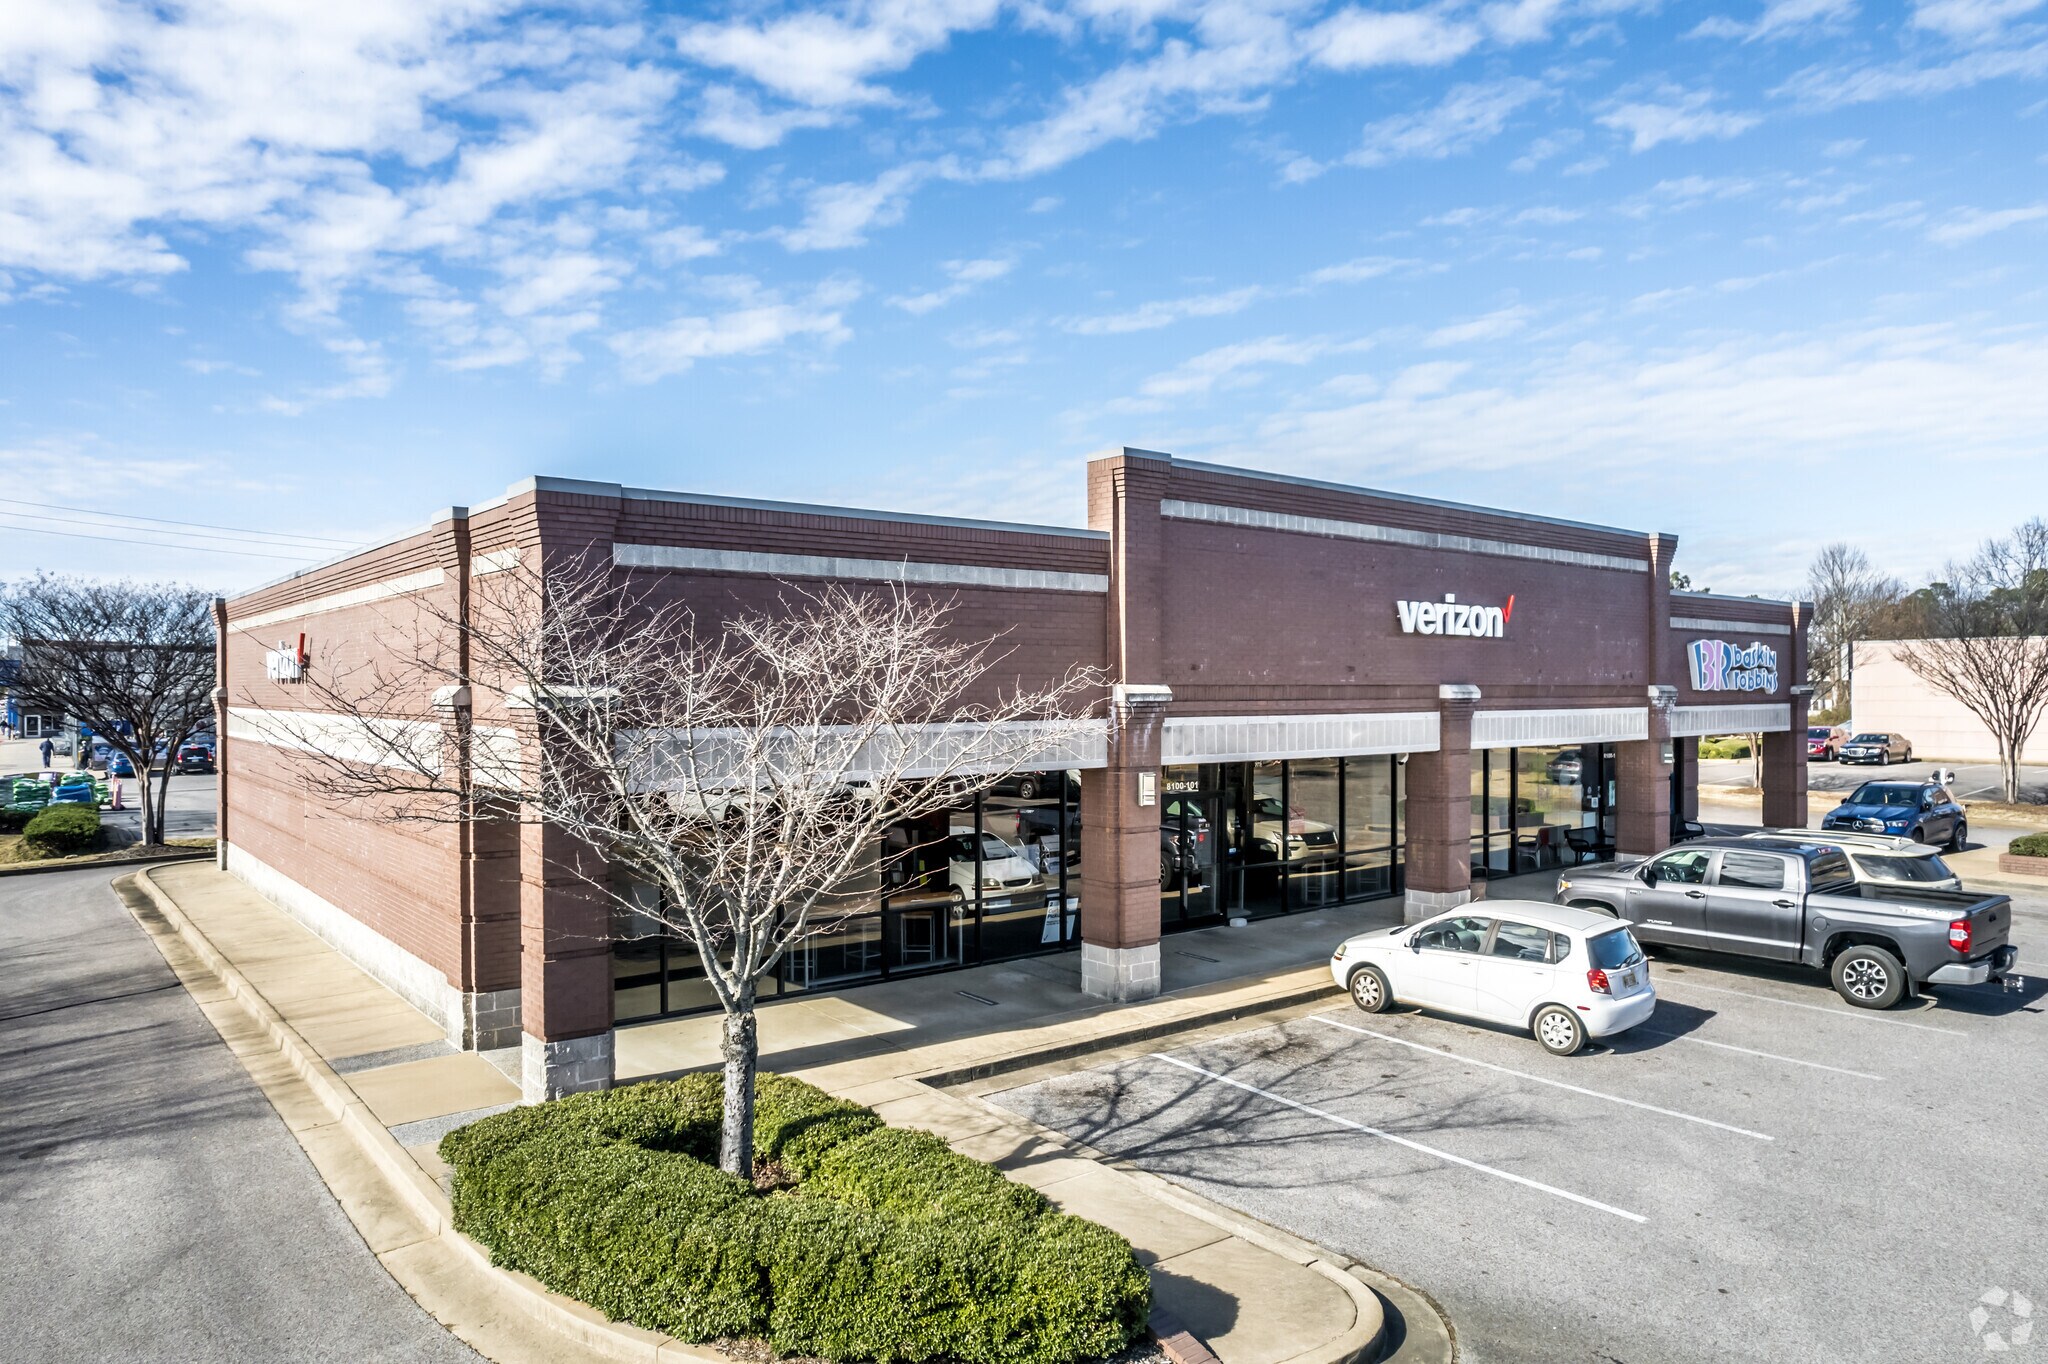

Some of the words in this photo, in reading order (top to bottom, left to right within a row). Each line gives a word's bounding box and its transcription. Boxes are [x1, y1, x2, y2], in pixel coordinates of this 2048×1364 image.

[1397, 593, 1504, 638] verizon
[1692, 639, 1732, 691] BR
[1166, 780, 1199, 791] 8100-101
